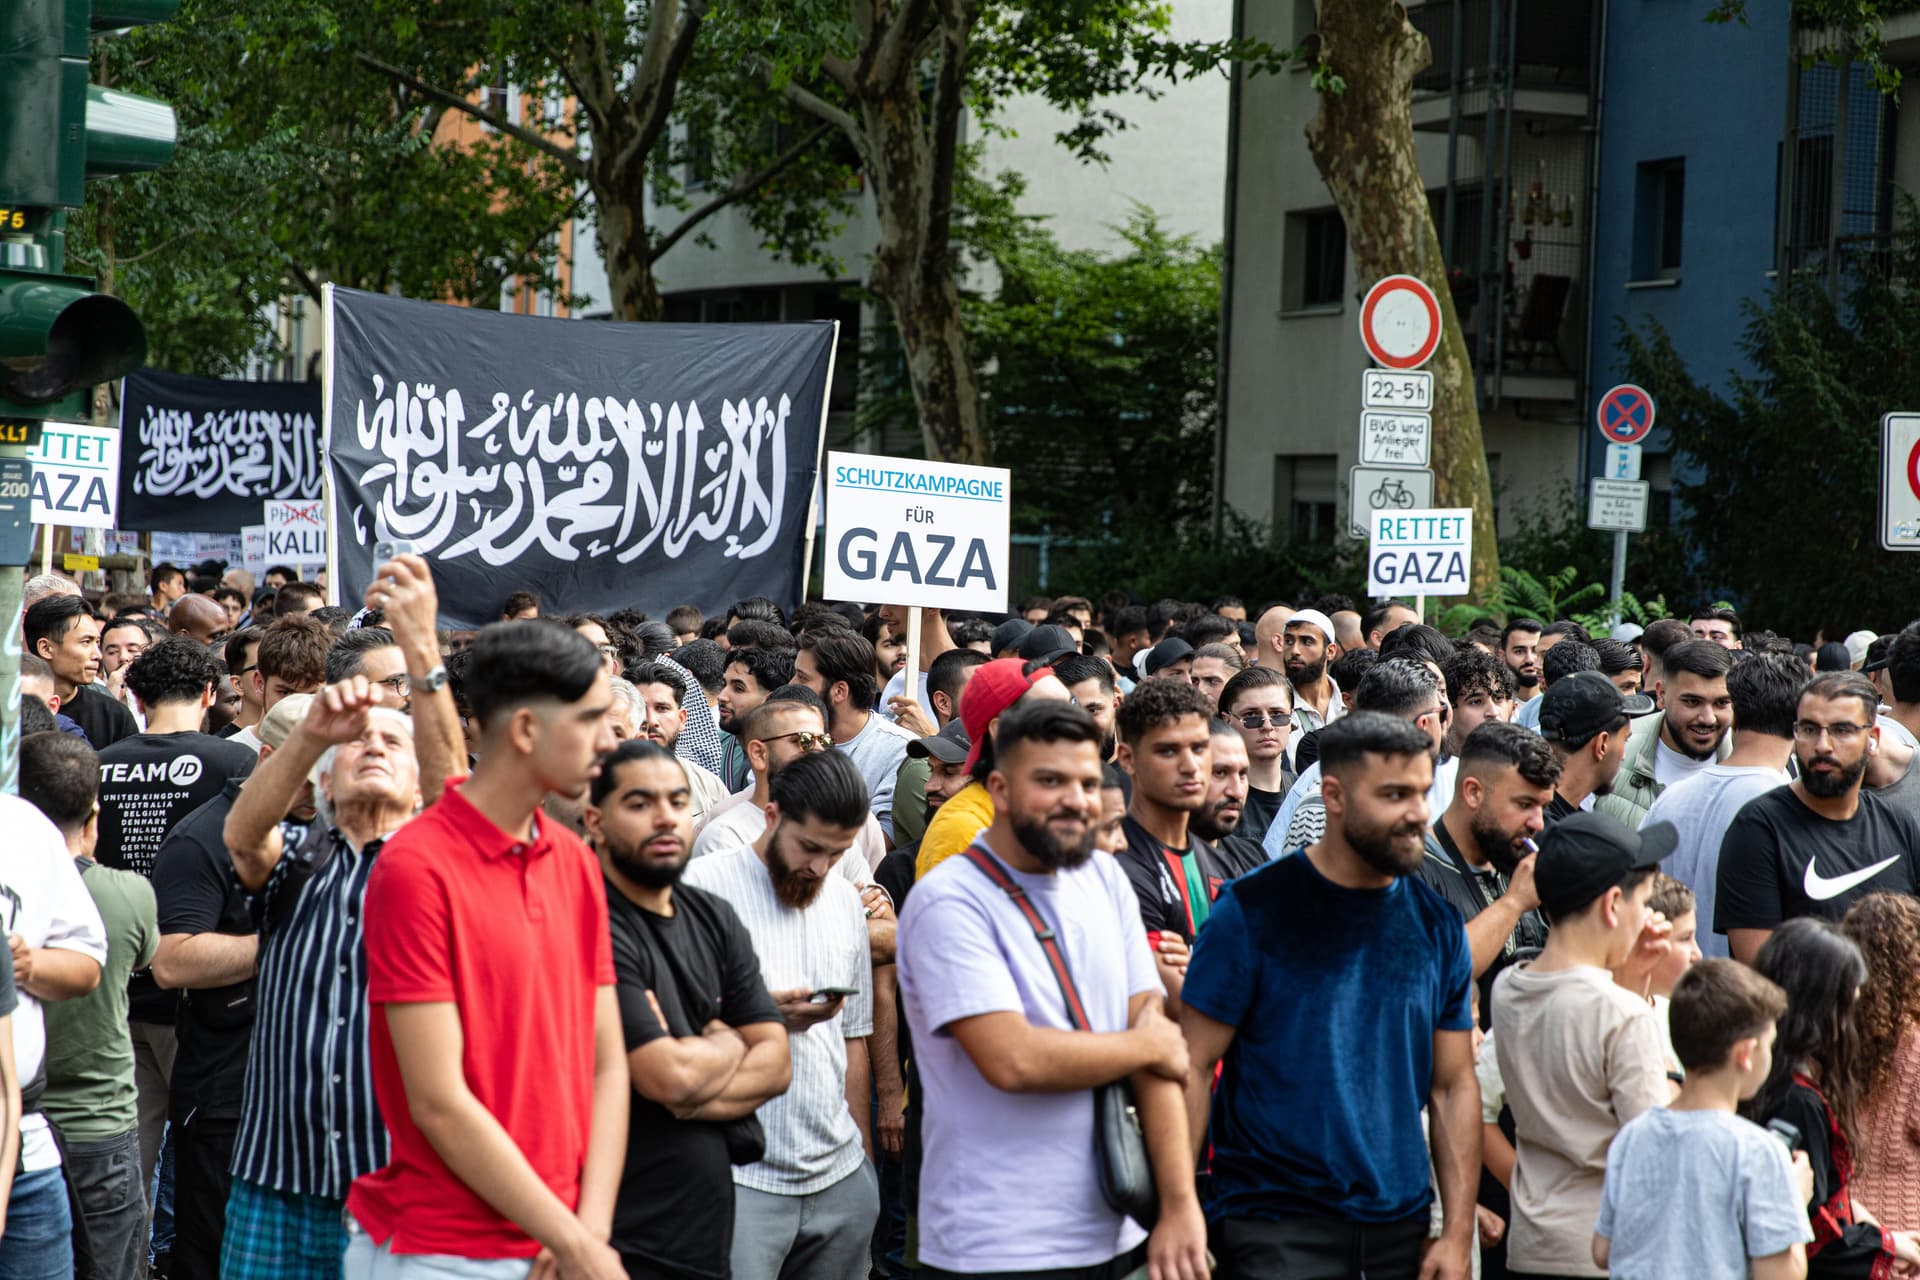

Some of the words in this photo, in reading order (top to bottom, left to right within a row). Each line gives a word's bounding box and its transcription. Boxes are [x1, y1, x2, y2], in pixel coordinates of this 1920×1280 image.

[1369, 419, 1396, 432] BVG
[1401, 422, 1424, 434] und
[26, 431, 110, 462] TTET
[1385, 448, 1404, 459] frei
[836, 466, 1003, 498] SCHUTZKAMPAGNE
[31, 471, 111, 515] AZA
[905, 505, 934, 524] FÜR
[1380, 517, 1465, 540] RETTET
[269, 530, 327, 555] KALI
[838, 527, 997, 591] GAZA
[1373, 551, 1467, 585] GAZA
[100, 763, 168, 782] TEAM
[104, 793, 140, 801] UNITED
[142, 792, 190, 801] KINGDOM
[118, 801, 173, 809] AUSTRALIA
[121, 818, 167, 826] DENMARK
[123, 810, 166, 818] BELGIUM
[121, 843, 159, 851] GERMAN
[123, 852, 157, 860] IRELAN
[131, 860, 152, 868] ITAL
